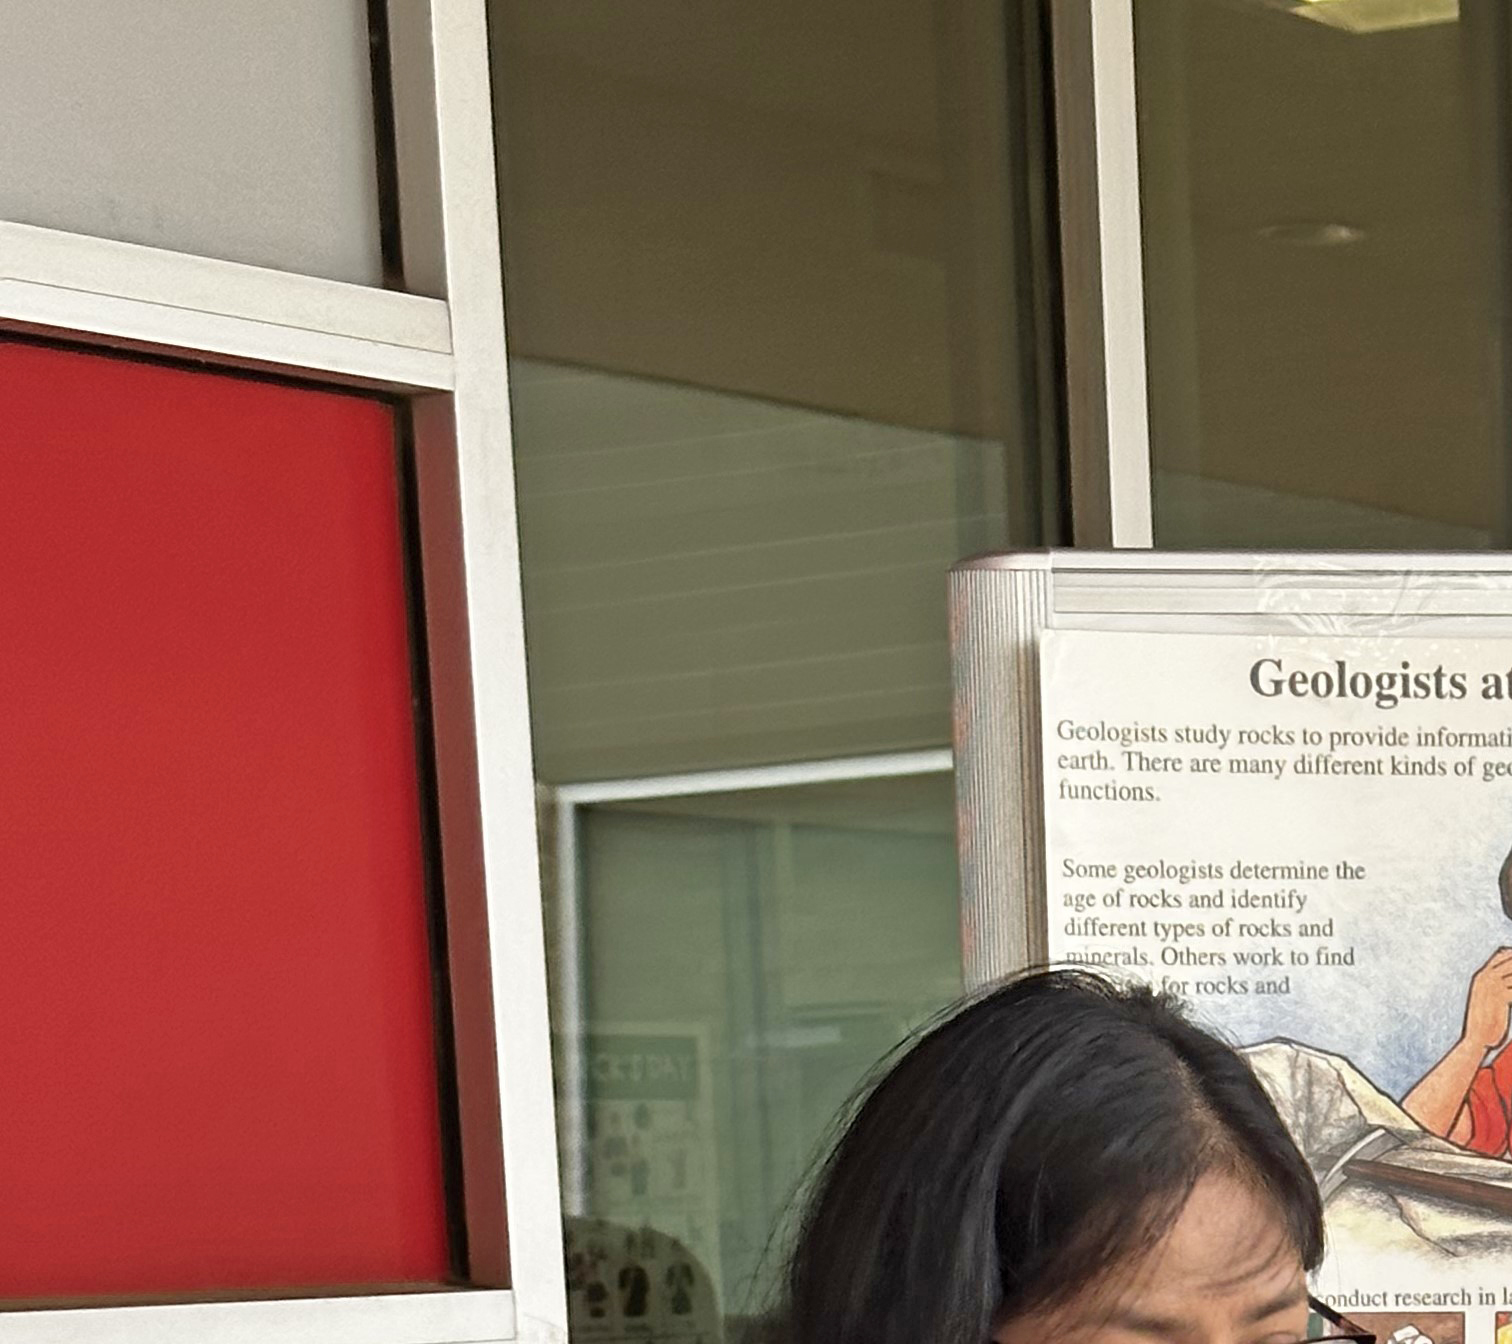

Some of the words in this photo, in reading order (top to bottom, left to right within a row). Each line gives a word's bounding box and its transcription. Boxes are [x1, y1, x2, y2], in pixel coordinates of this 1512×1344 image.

[1250, 658, 1467, 709] Geologists
[1056, 720, 1167, 747] Geologists
[1175, 725, 1231, 749] study
[1238, 725, 1295, 746] rocks
[1302, 730, 1322, 745] to
[1329, 727, 1409, 752] provide
[1057, 752, 1115, 770] earth.
[1122, 752, 1182, 772] There
[1190, 758, 1221, 773] are
[1229, 759, 1286, 779] many
[1293, 755, 1384, 775] different
[1390, 755, 1447, 776] kinds
[1453, 756, 1477, 776] of
[1059, 779, 1161, 801] functions.
[1062, 859, 1116, 879] Some
[1124, 860, 1223, 884] geologists
[1230, 861, 1329, 880] determine
[1336, 861, 1366, 879] the
[1063, 894, 1096, 911] age
[1103, 889, 1124, 907] of
[1129, 890, 1182, 908] rocks
[1188, 890, 1223, 908] and
[1231, 889, 1307, 913] identify
[1395, 1289, 1470, 1306] research
[1479, 1287, 1495, 1306] in
